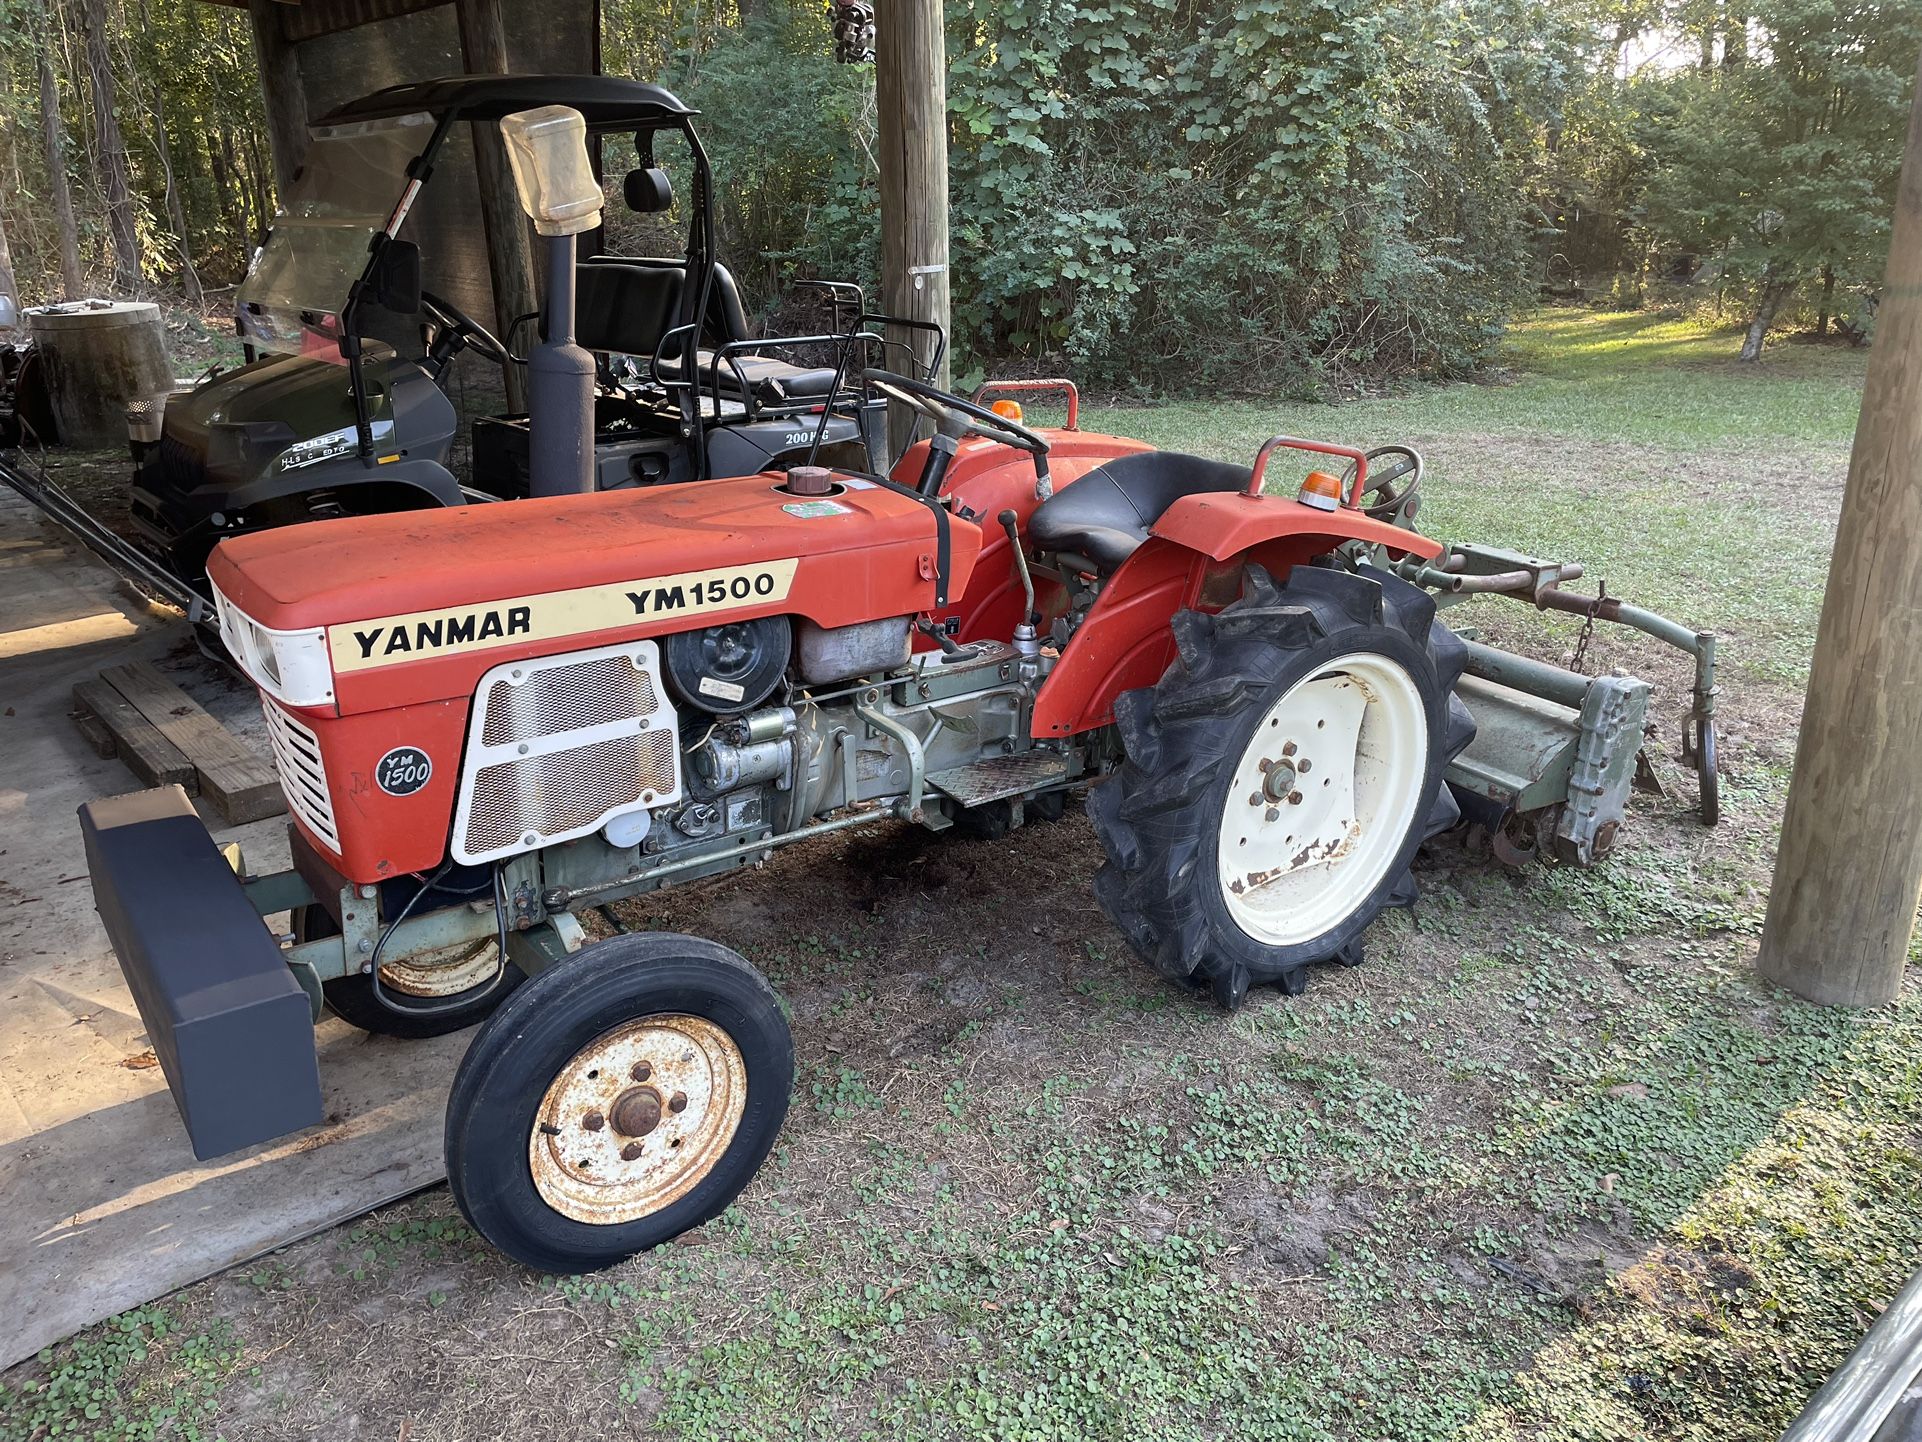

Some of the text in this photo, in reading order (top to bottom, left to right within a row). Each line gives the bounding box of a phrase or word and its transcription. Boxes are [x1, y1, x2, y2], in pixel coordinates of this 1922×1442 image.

[291, 432, 345, 453] 200EF
[785, 432, 808, 445] 200
[624, 573, 774, 615] YM1500
[353, 606, 531, 659] YANMAR
[386, 754, 414, 769] YM
[384, 763, 429, 788] 1500
